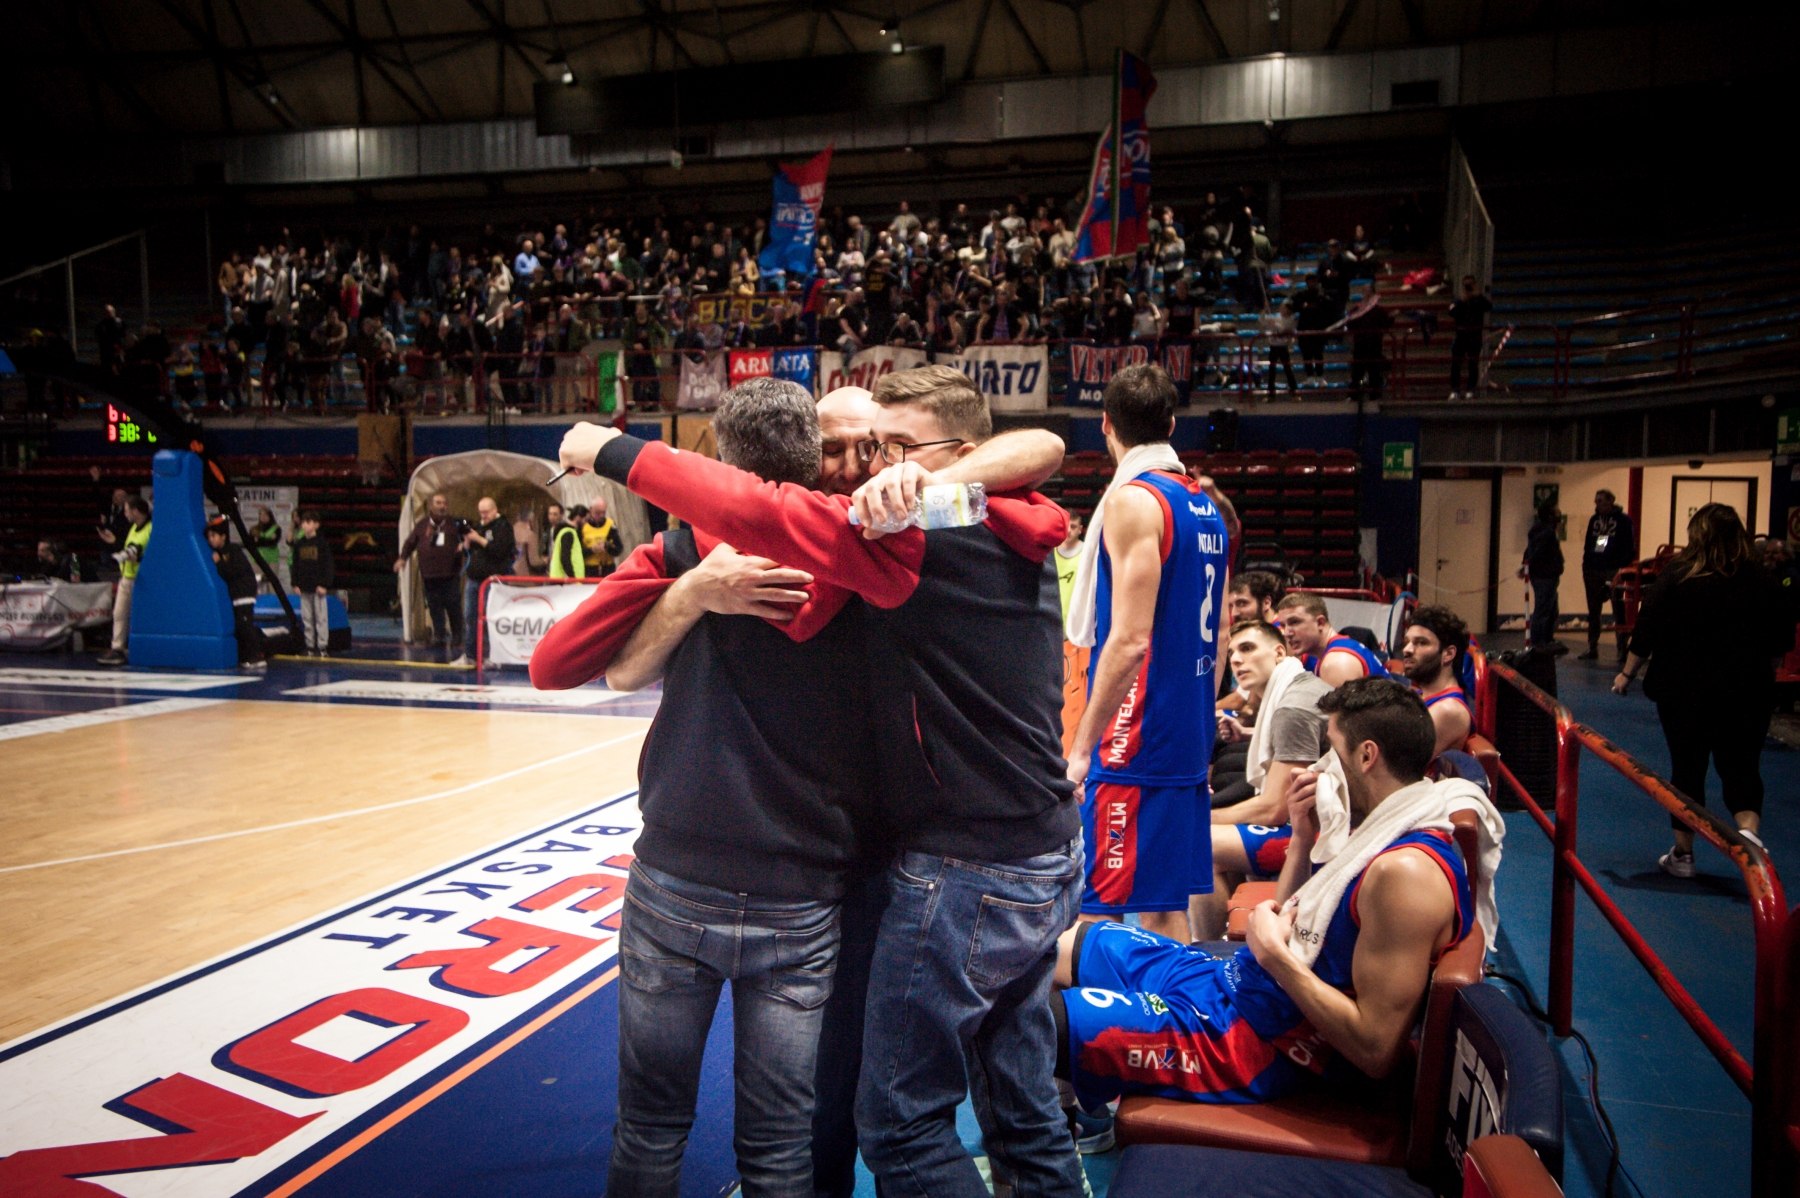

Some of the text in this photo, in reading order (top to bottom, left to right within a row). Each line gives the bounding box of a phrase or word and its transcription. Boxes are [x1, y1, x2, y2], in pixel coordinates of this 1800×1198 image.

[733, 354, 810, 374] ARMATA
[1070, 345, 1191, 384] VETERNI
[1080, 388, 1103, 402] MO
[1107, 673, 1140, 764] MONTECA
[321, 823, 637, 950] BASKET
